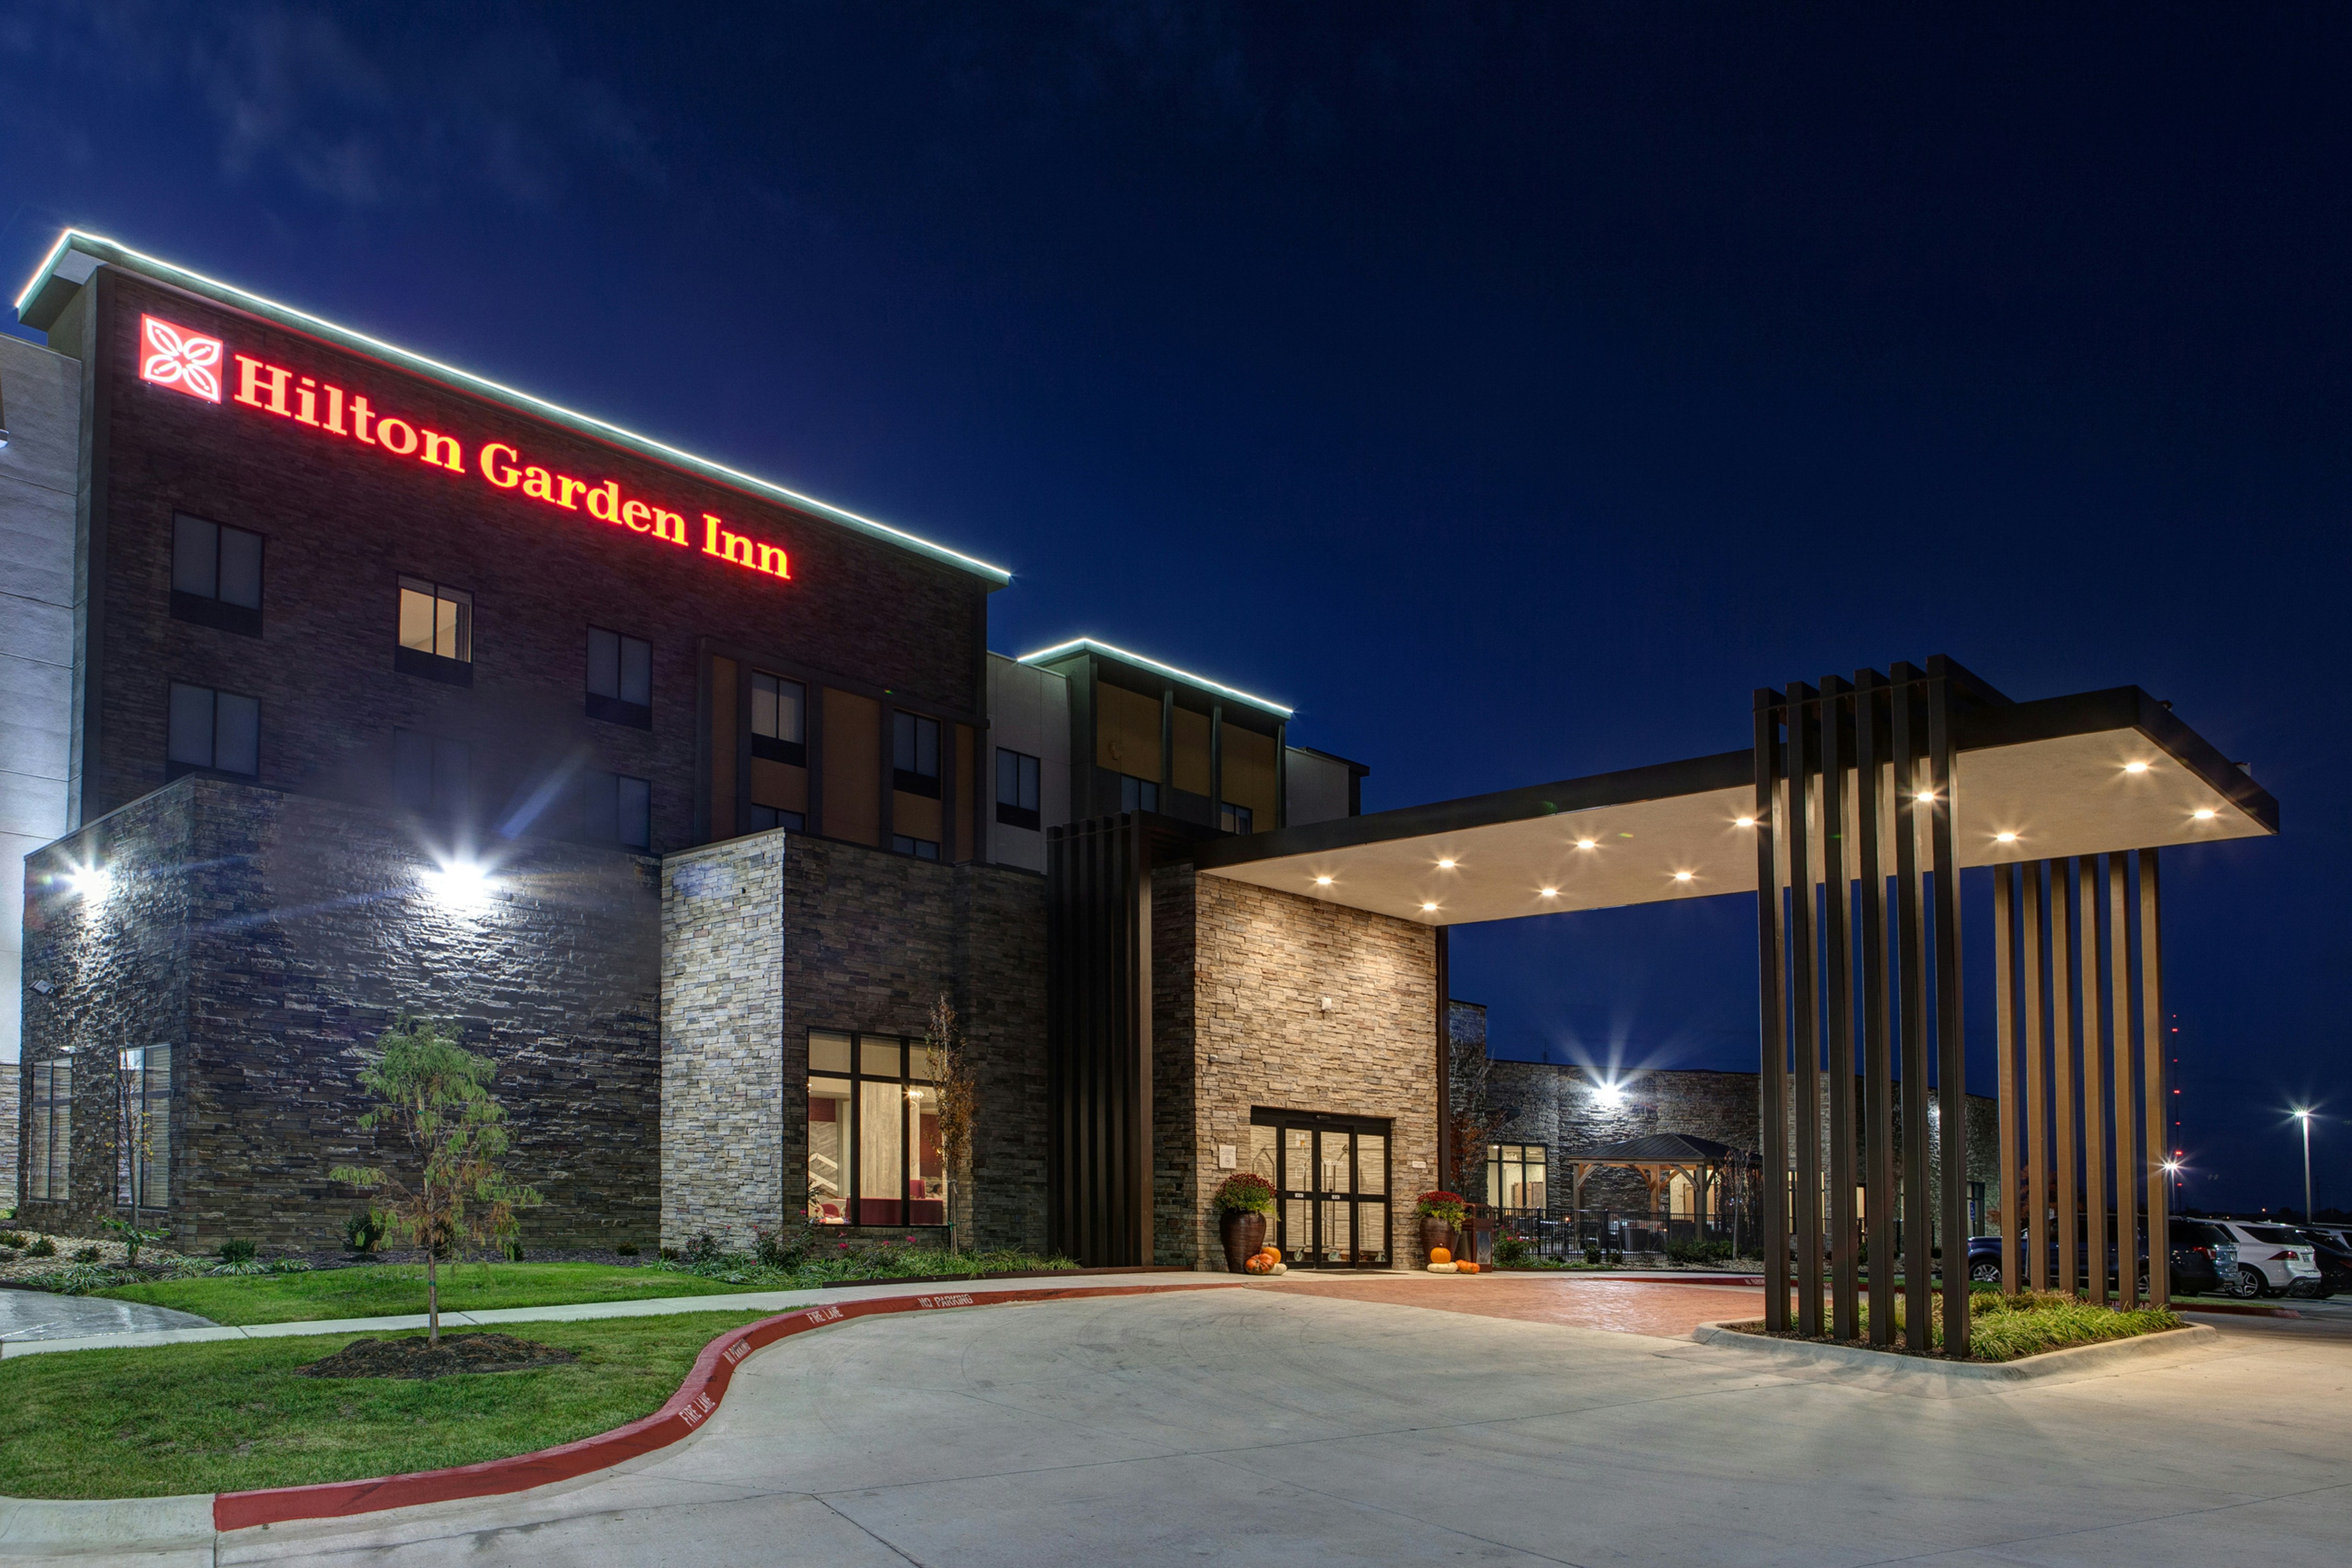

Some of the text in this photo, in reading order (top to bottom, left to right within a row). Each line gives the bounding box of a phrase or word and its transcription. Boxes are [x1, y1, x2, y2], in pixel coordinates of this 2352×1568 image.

[234, 354, 791, 580] Hilton Garden Inn
[917, 1294, 973, 1308] NO PARKING
[805, 1306, 844, 1324] FIRE LANE
[678, 1392, 716, 1427] FIRE LANE
